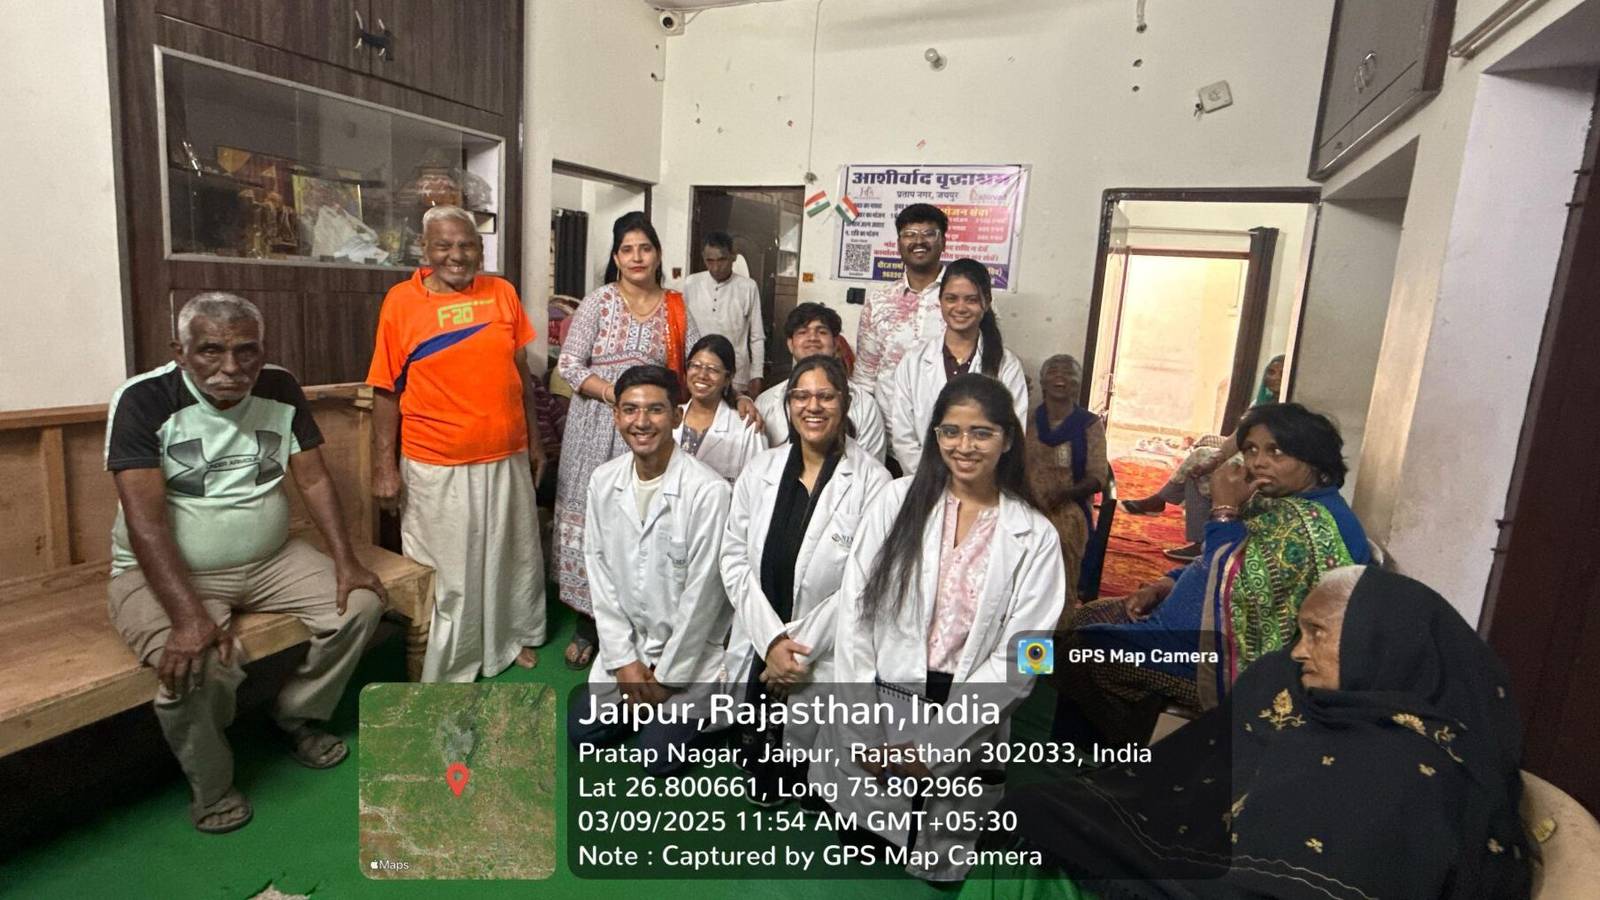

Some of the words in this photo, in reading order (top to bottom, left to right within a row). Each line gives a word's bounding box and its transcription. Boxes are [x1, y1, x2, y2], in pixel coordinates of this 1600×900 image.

[852, 168, 931, 185] आशीर्वाद
[936, 172, 1010, 189] वृद्धाश्रम
[896, 190, 915, 200] प्रताप
[917, 190, 934, 200] नगर,
[936, 190, 959, 202] जयपुर
[437, 304, 474, 329] F20
